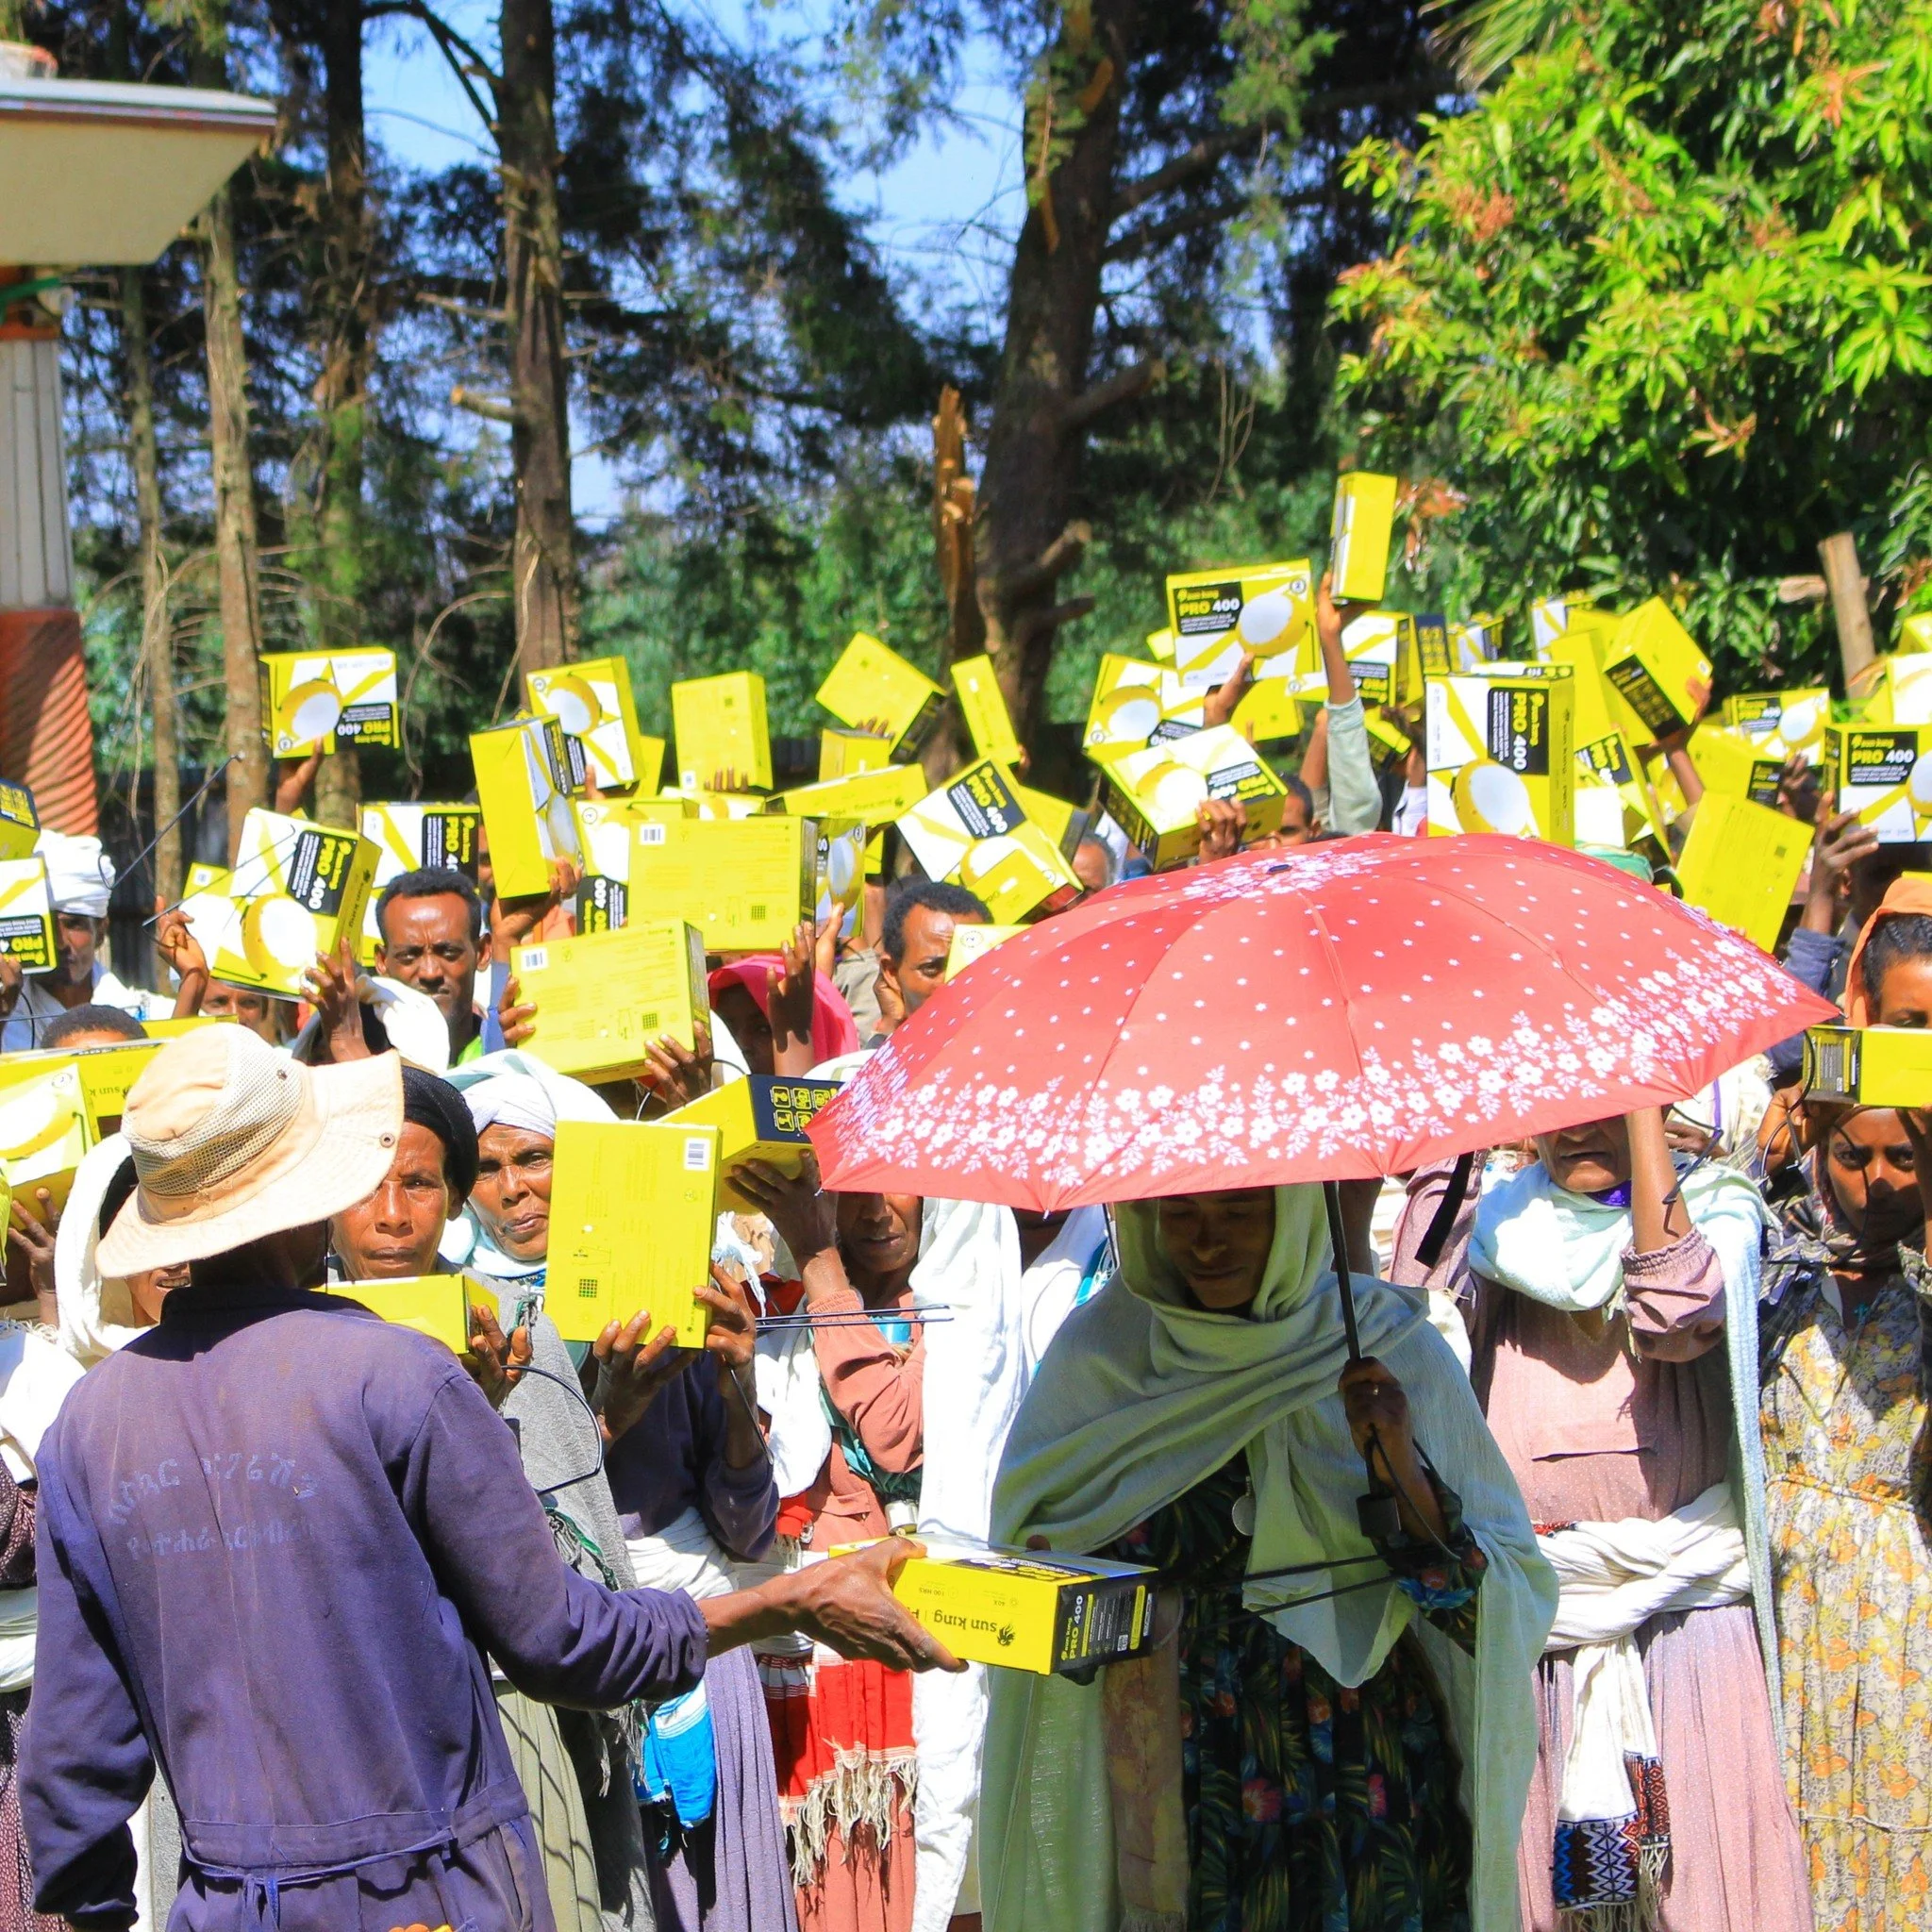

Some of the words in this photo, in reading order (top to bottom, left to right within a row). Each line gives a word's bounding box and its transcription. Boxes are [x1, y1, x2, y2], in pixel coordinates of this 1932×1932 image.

[1179, 601, 1211, 616] PRO
[1212, 597, 1241, 613] 400
[1512, 691, 1527, 733] PRO
[337, 723, 361, 737] 400
[363, 720, 391, 734] PRO
[1513, 734, 1527, 771] 400
[1851, 749, 1885, 764] PRO
[1885, 748, 1915, 763] 400
[558, 762, 568, 794] 400
[966, 774, 991, 808] PRO
[987, 806, 1008, 833] 400
[445, 816, 459, 852] PRO
[316, 837, 337, 876] PRO
[308, 875, 326, 910] 400
[594, 878, 607, 909] 400
[10, 934, 44, 953] PRO
[99, 1086, 121, 1095] sun
[933, 1608, 967, 1631] king
[971, 1619, 998, 1633] sun
[1065, 1616, 1074, 1636] king
[1068, 1626, 1079, 1659] PRO
[1074, 1594, 1084, 1624] 400
